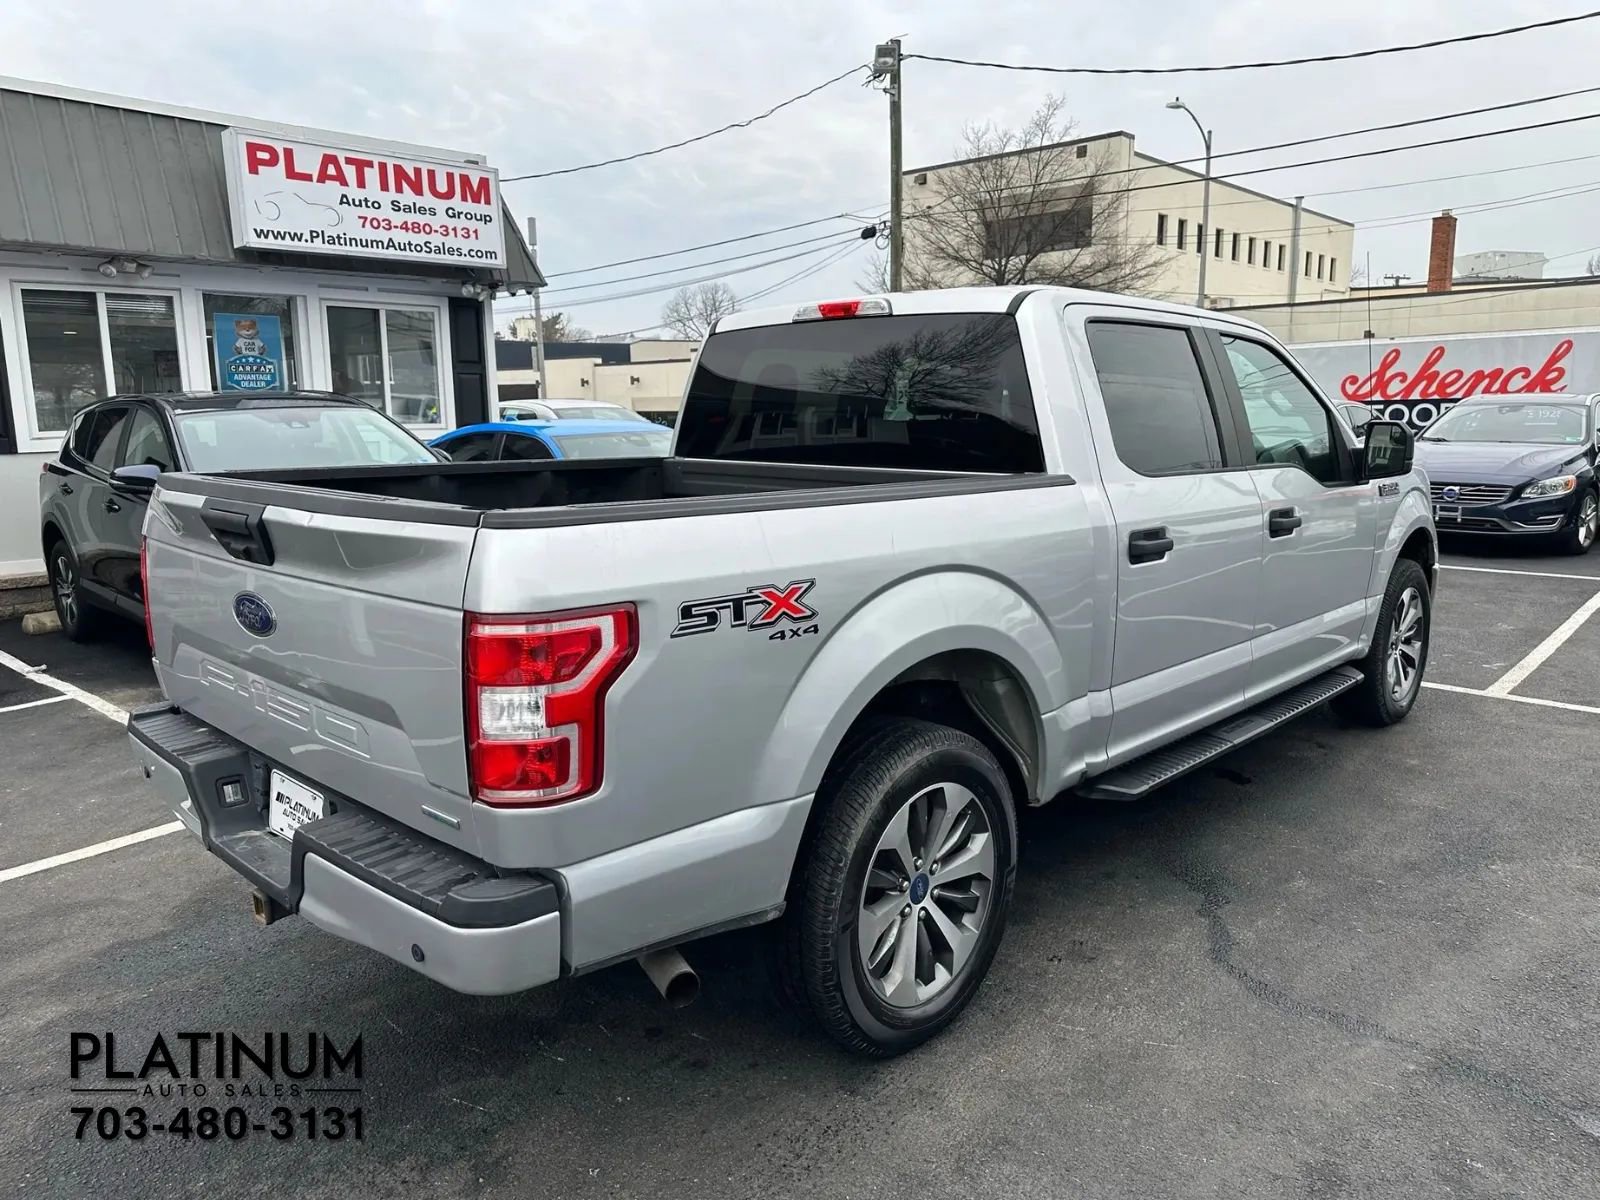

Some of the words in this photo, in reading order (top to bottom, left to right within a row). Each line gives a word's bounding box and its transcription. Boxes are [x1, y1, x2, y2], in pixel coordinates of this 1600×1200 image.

[245, 141, 492, 206] PLATINUM
[338, 193, 382, 210] Auto
[390, 199, 437, 217] Sales
[445, 206, 493, 224] Group
[252, 226, 497, 261] www.PlatinumAutoSales.com
[357, 215, 480, 241] 703-480-3131
[231, 365, 274, 373] CARFAX
[1341, 339, 1574, 400] Schenck
[670, 578, 820, 638] STX
[282, 808, 297, 821] AUTO
